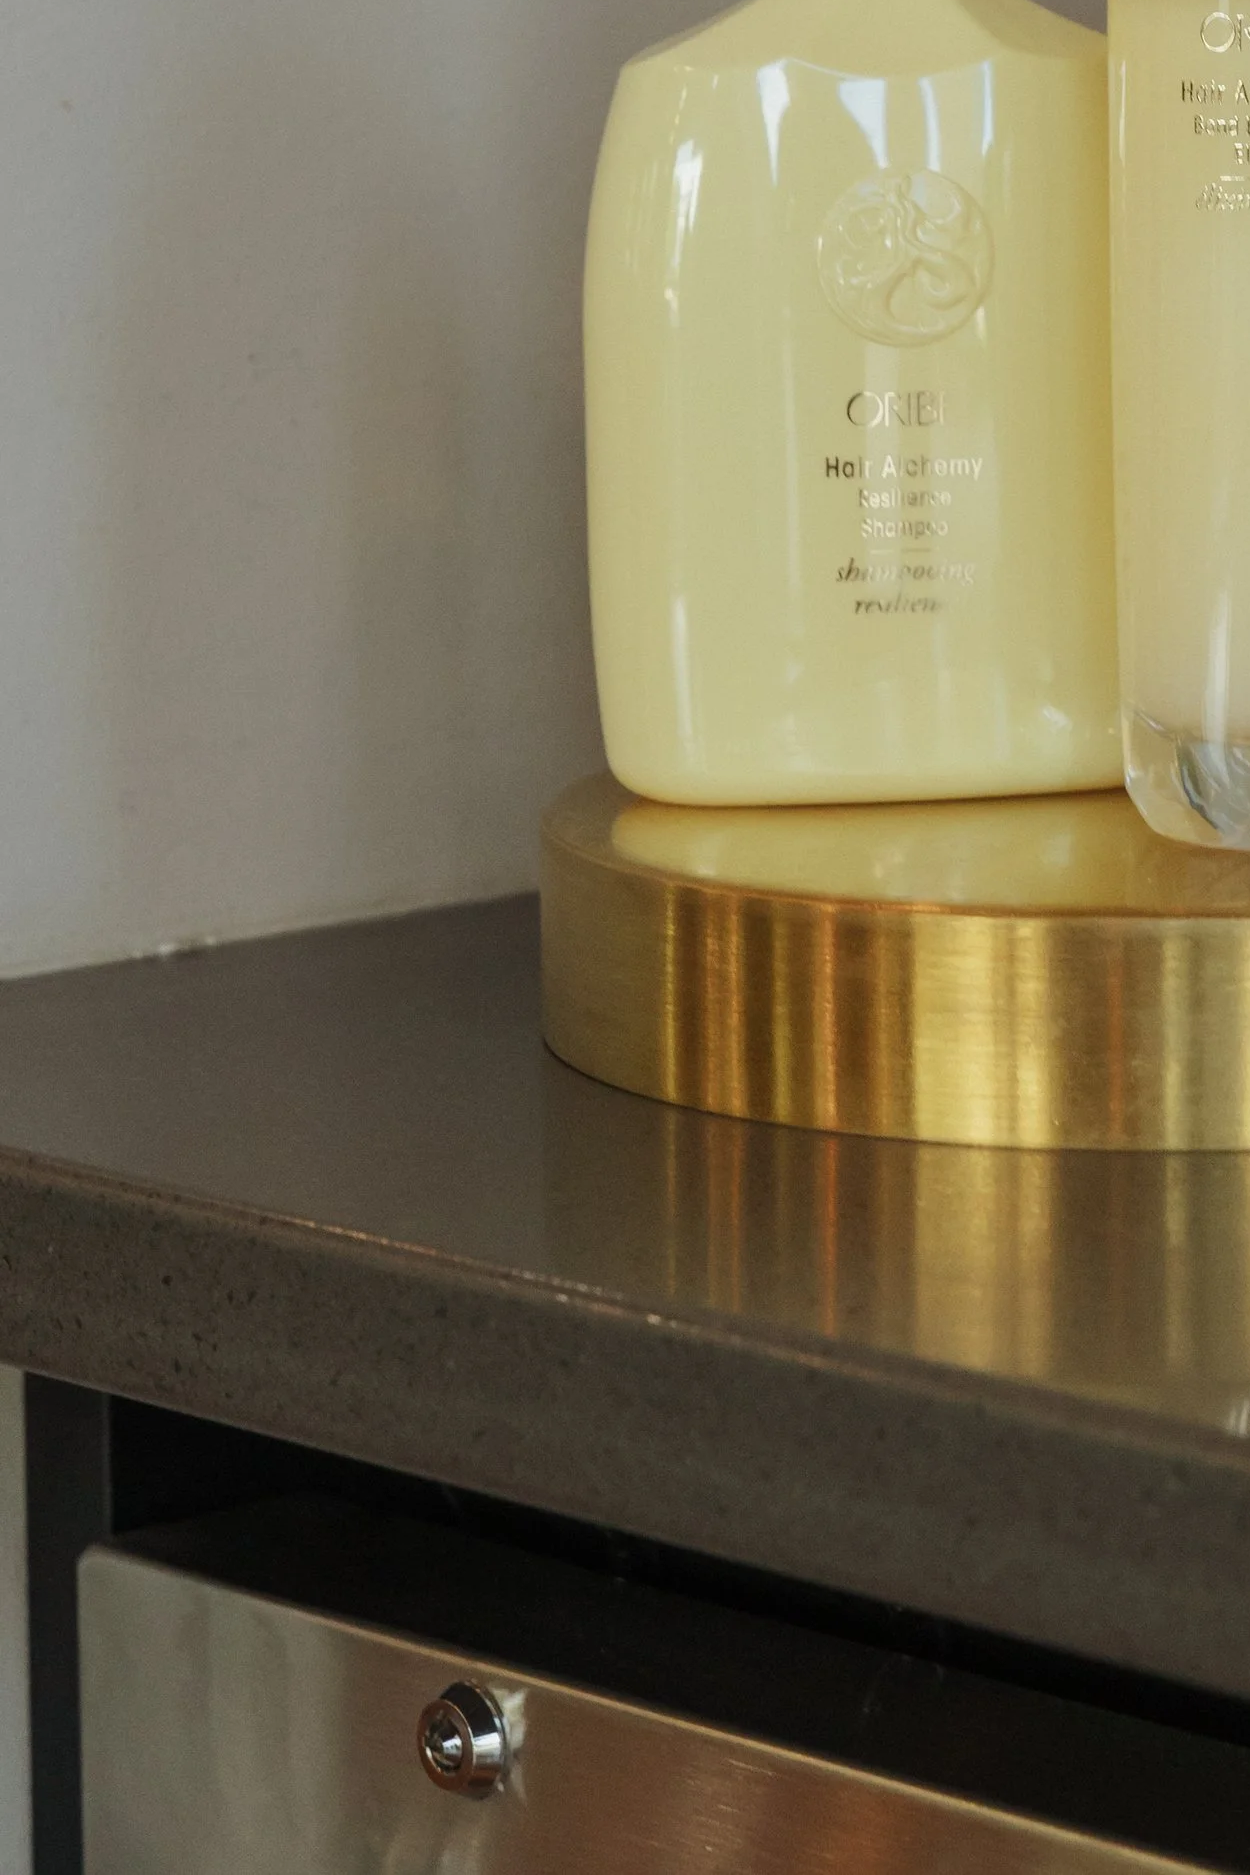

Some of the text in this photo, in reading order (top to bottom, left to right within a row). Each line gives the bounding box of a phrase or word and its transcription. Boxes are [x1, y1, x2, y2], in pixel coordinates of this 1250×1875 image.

[1181, 78, 1226, 105] Hair
[825, 455, 984, 482] Hair Alchemy
[861, 518, 949, 540] Shampoo
